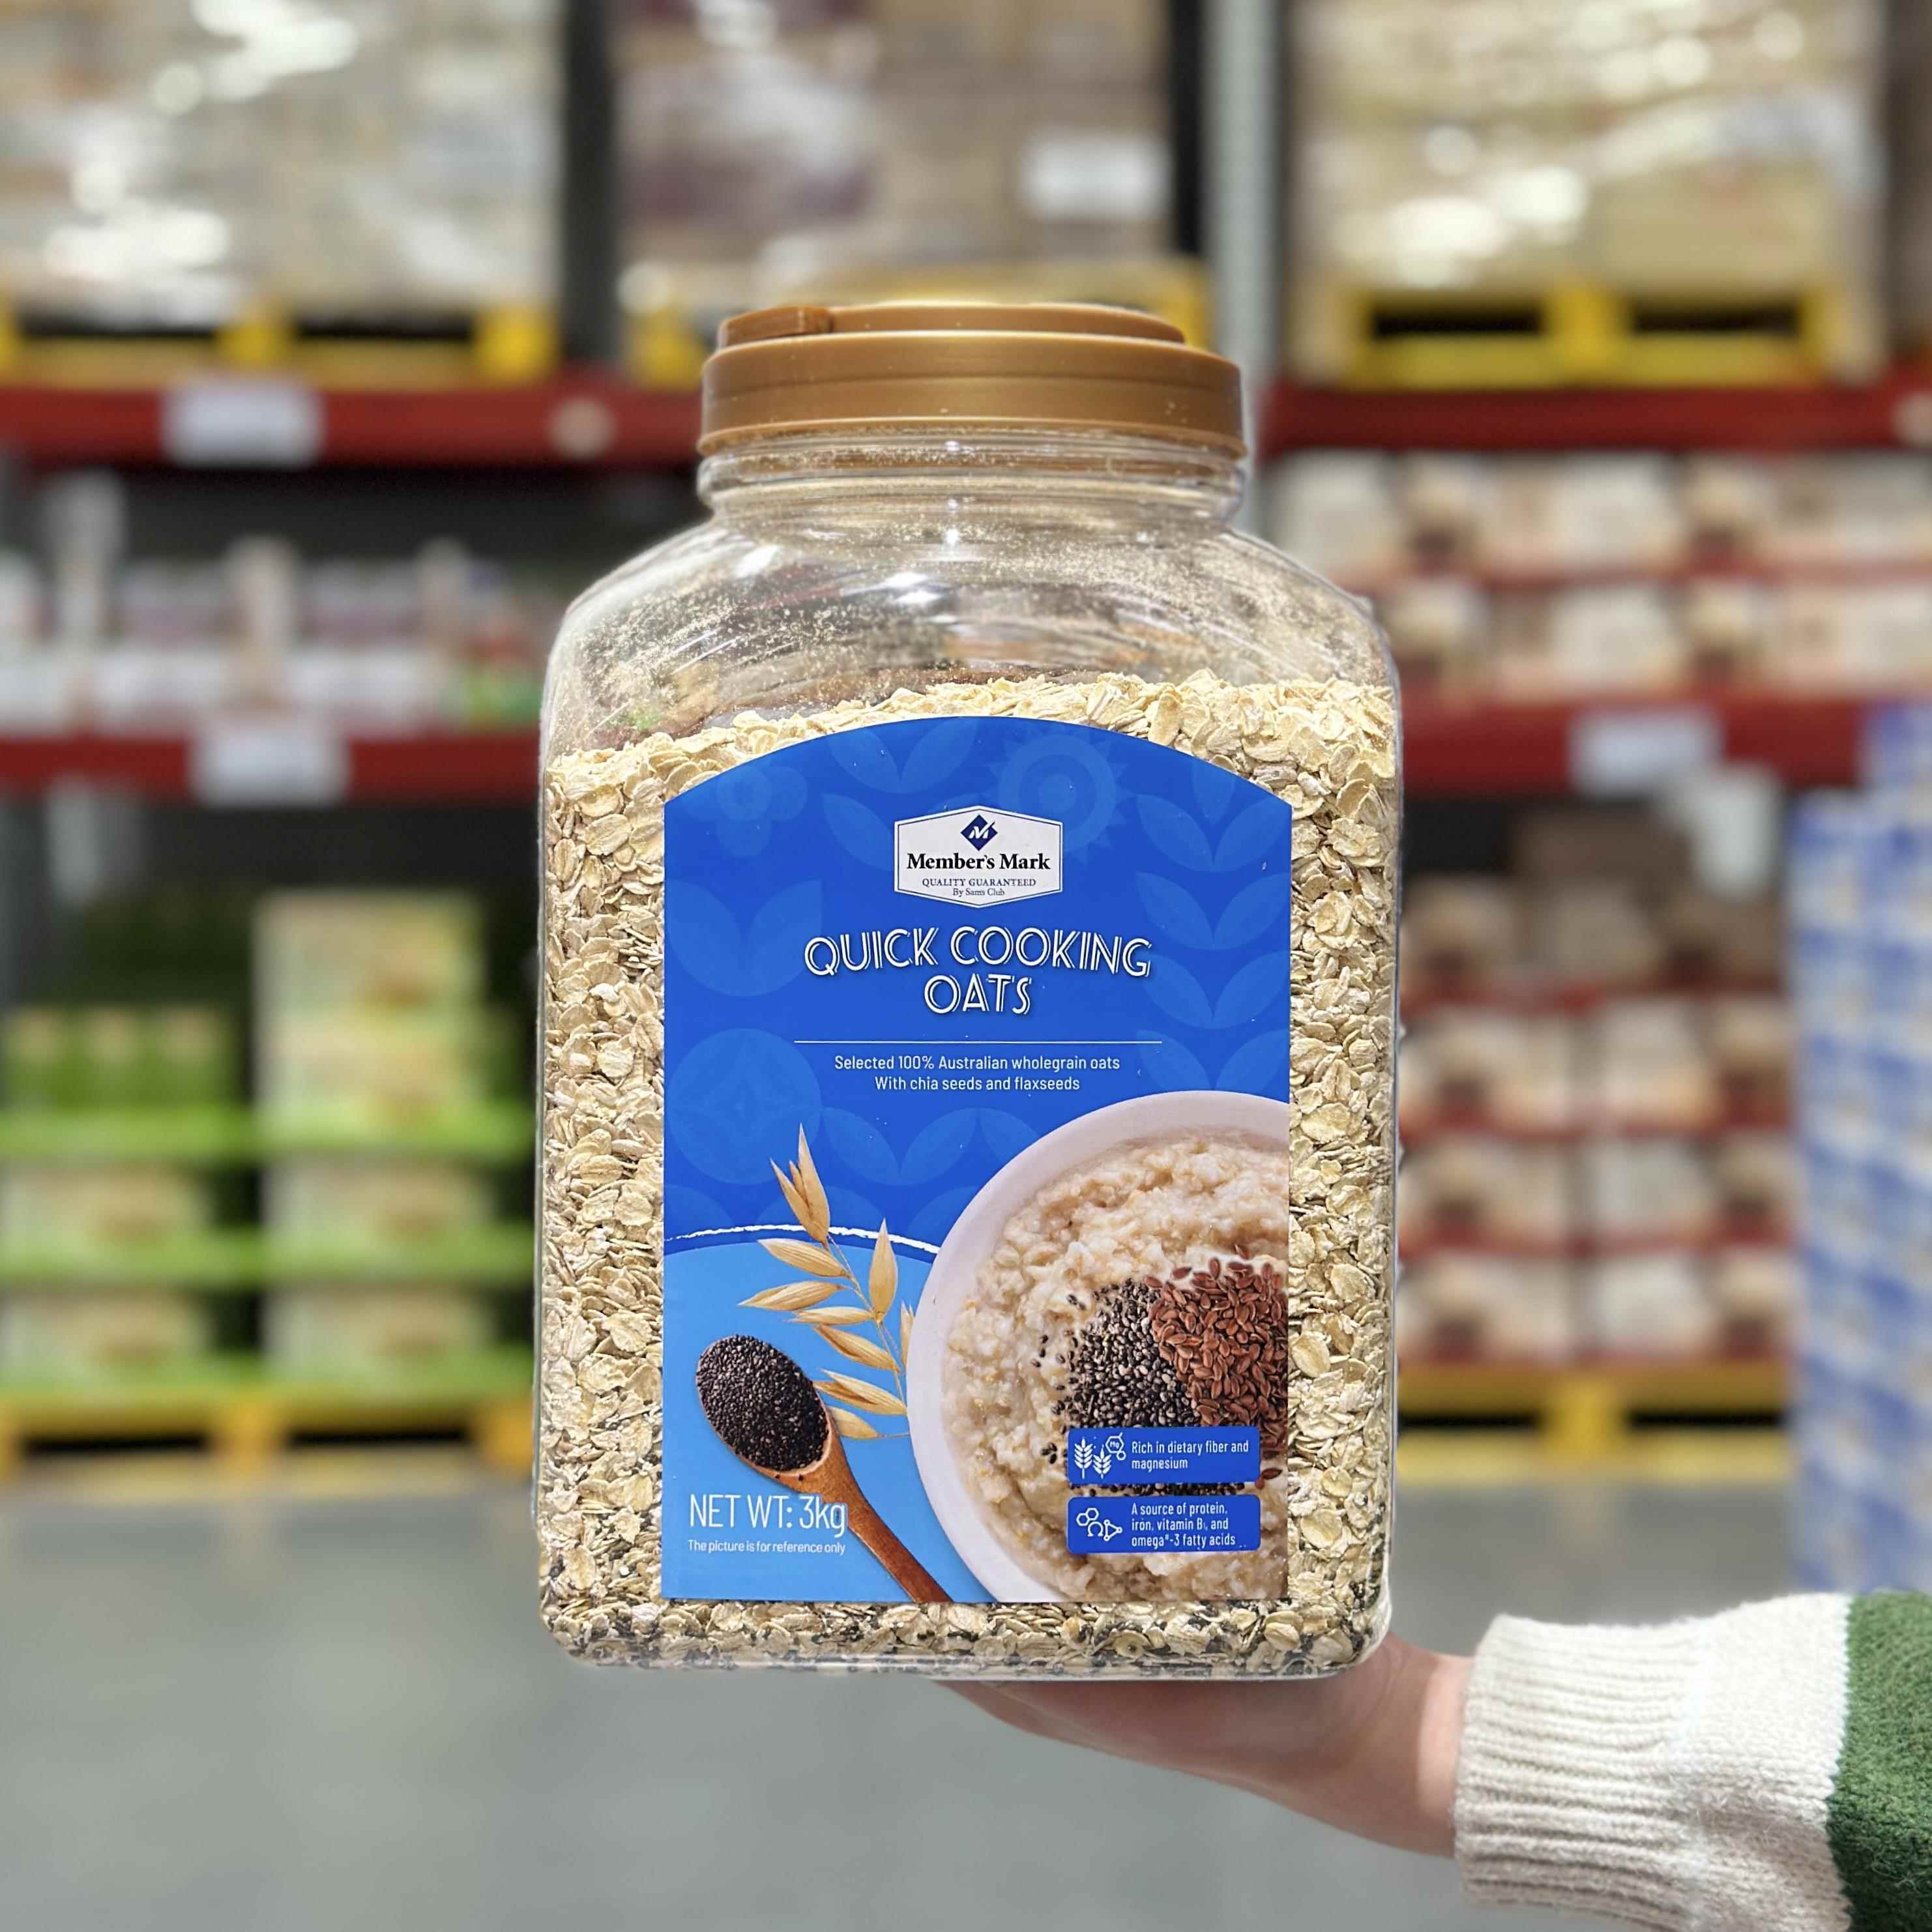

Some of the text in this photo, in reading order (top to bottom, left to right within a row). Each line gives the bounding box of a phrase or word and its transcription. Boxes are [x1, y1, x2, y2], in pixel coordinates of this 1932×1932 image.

[907, 852, 1051, 870] Member's Mark
[922, 878, 1036, 888] QUALITY GUARANTEED
[952, 888, 964, 898] By
[804, 926, 1152, 978] QUICK COOKING
[923, 973, 1032, 1015] OATS
[834, 1055, 1120, 1073] Selected 100% Australian wholegrain oats
[875, 1076, 1080, 1090] With chia seeds and flaxseeds
[1132, 1440, 1249, 1456] Rich in dietary fiber and
[1132, 1457, 1188, 1472] magnesium
[690, 1494, 845, 1538] NET WT: 3kg
[1132, 1502, 1137, 1515] A
[1140, 1505, 1174, 1515] source
[1177, 1502, 1186, 1515] of
[1157, 1517, 1193, 1530] vitamin
[1210, 1517, 1229, 1530] and
[688, 1540, 845, 1556] The picture is for reference only
[1182, 1533, 1207, 1549] fatty
[1209, 1532, 1236, 1546] acids
